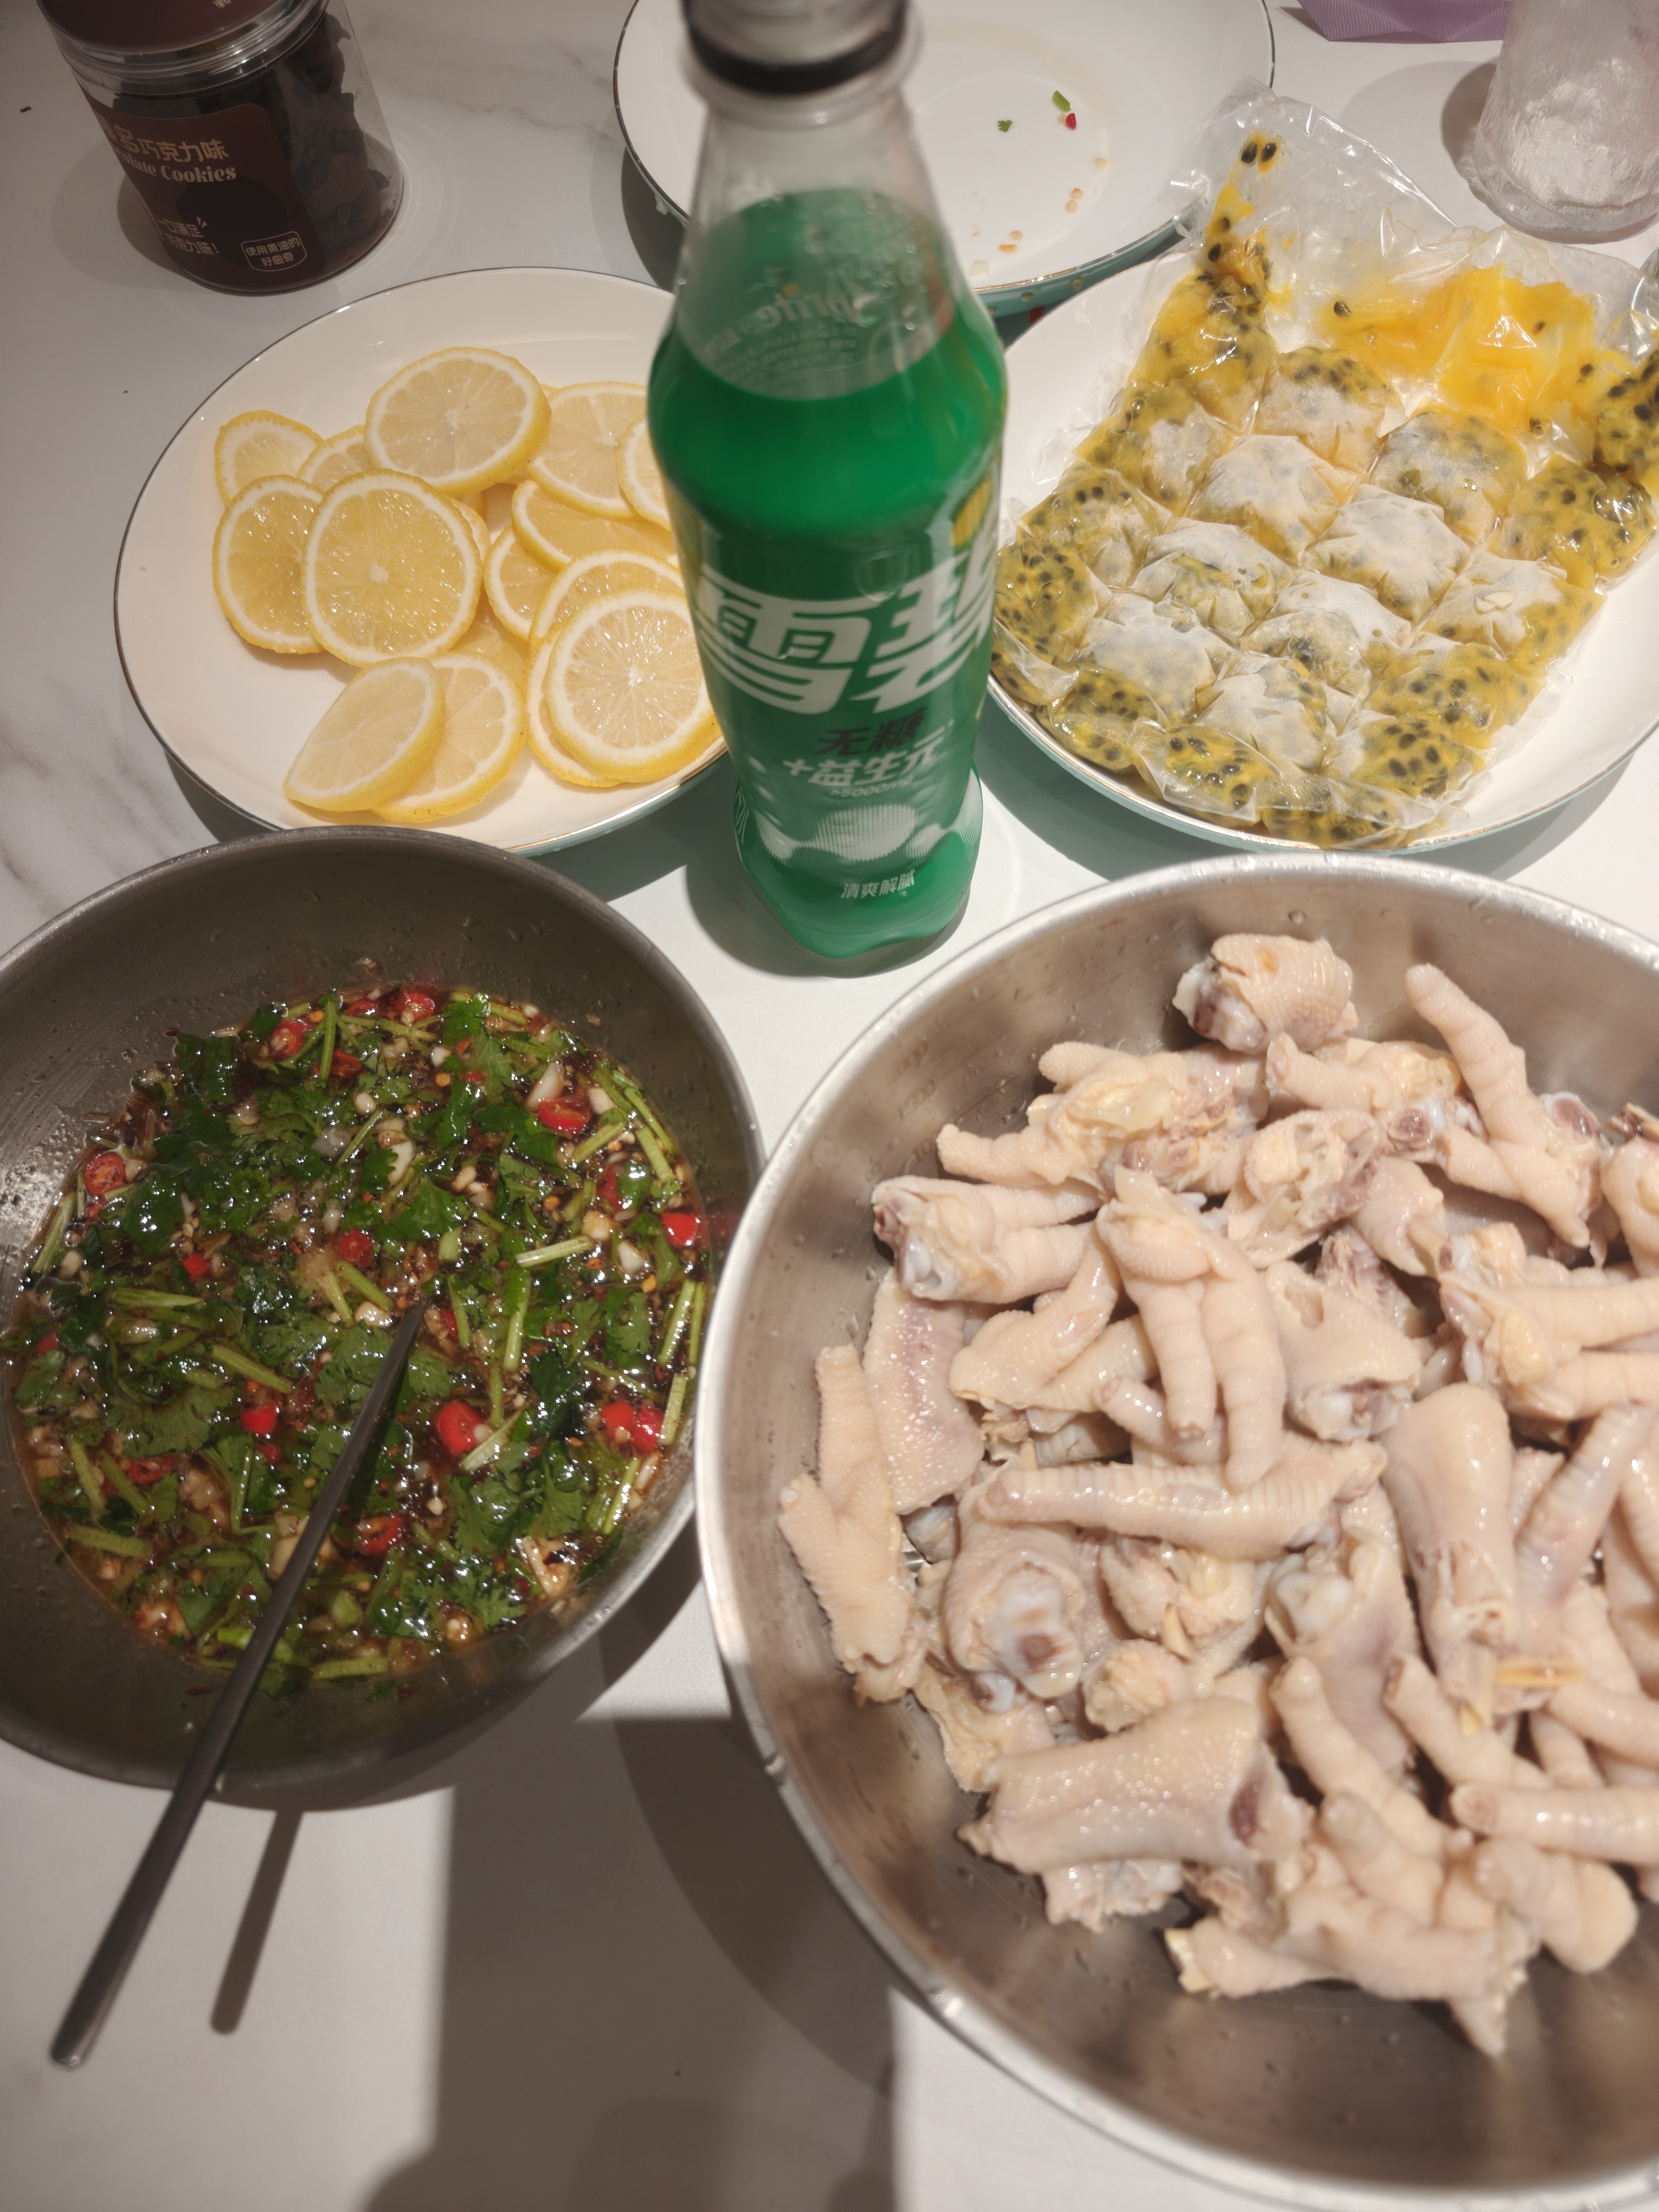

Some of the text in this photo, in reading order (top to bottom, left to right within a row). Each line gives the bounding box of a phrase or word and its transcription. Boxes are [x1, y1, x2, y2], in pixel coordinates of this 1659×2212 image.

[160, 165, 237, 183] Cookies
[157, 219, 204, 238] 一口满足
[246, 237, 300, 257] 使用黄油的
[261, 252, 294, 267] 好曲奇
[695, 532, 995, 714] 雪碧
[813, 706, 928, 756] 无糖
[841, 868, 916, 899] 清爽解腻
